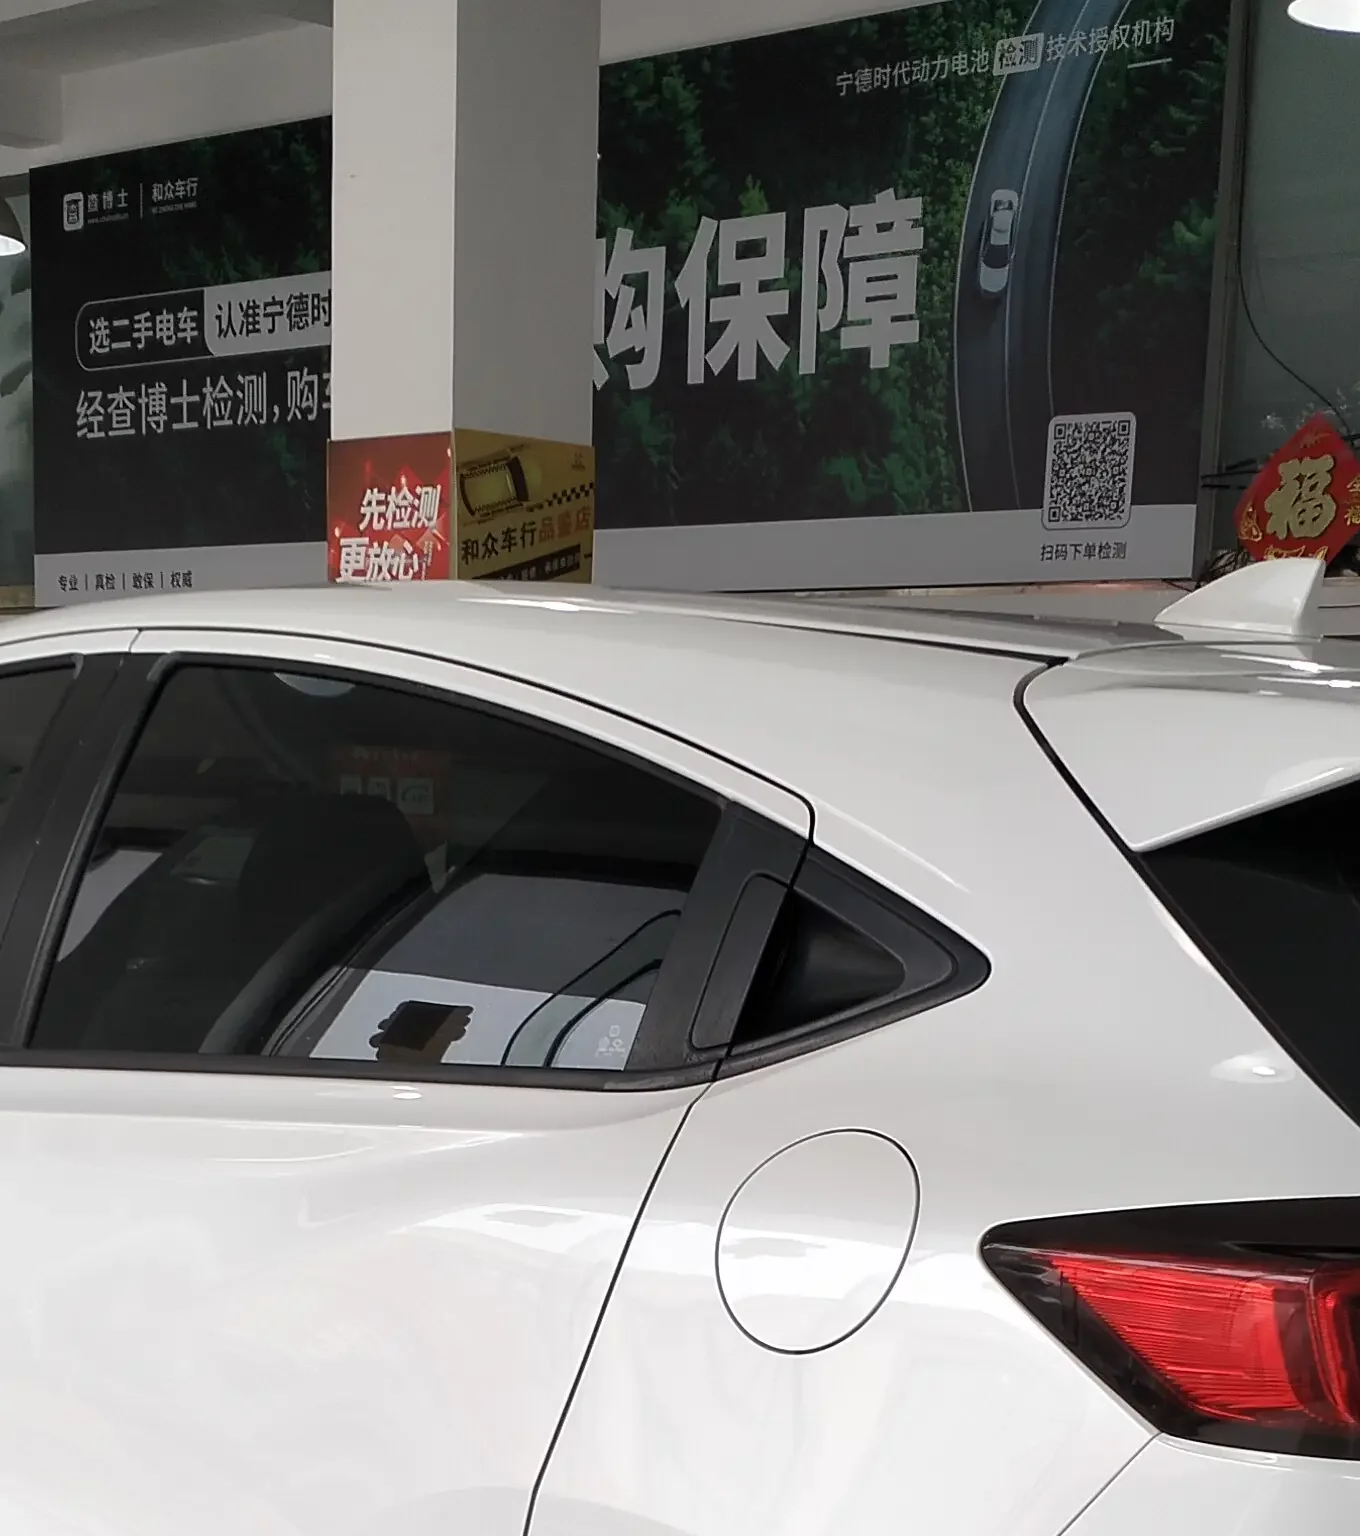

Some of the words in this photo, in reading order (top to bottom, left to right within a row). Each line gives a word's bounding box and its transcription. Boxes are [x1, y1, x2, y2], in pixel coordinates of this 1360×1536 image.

[151, 177, 199, 203] 和众车行
[89, 306, 199, 355] 选二手电车
[215, 290, 332, 339] 认准宁德时
[359, 484, 442, 532] 先检测
[1264, 454, 1338, 541] 福
[336, 537, 420, 583] 更放心
[1040, 541, 1128, 561] 扫码下单检测
[57, 573, 80, 592] 专业
[169, 570, 193, 589] 权威
